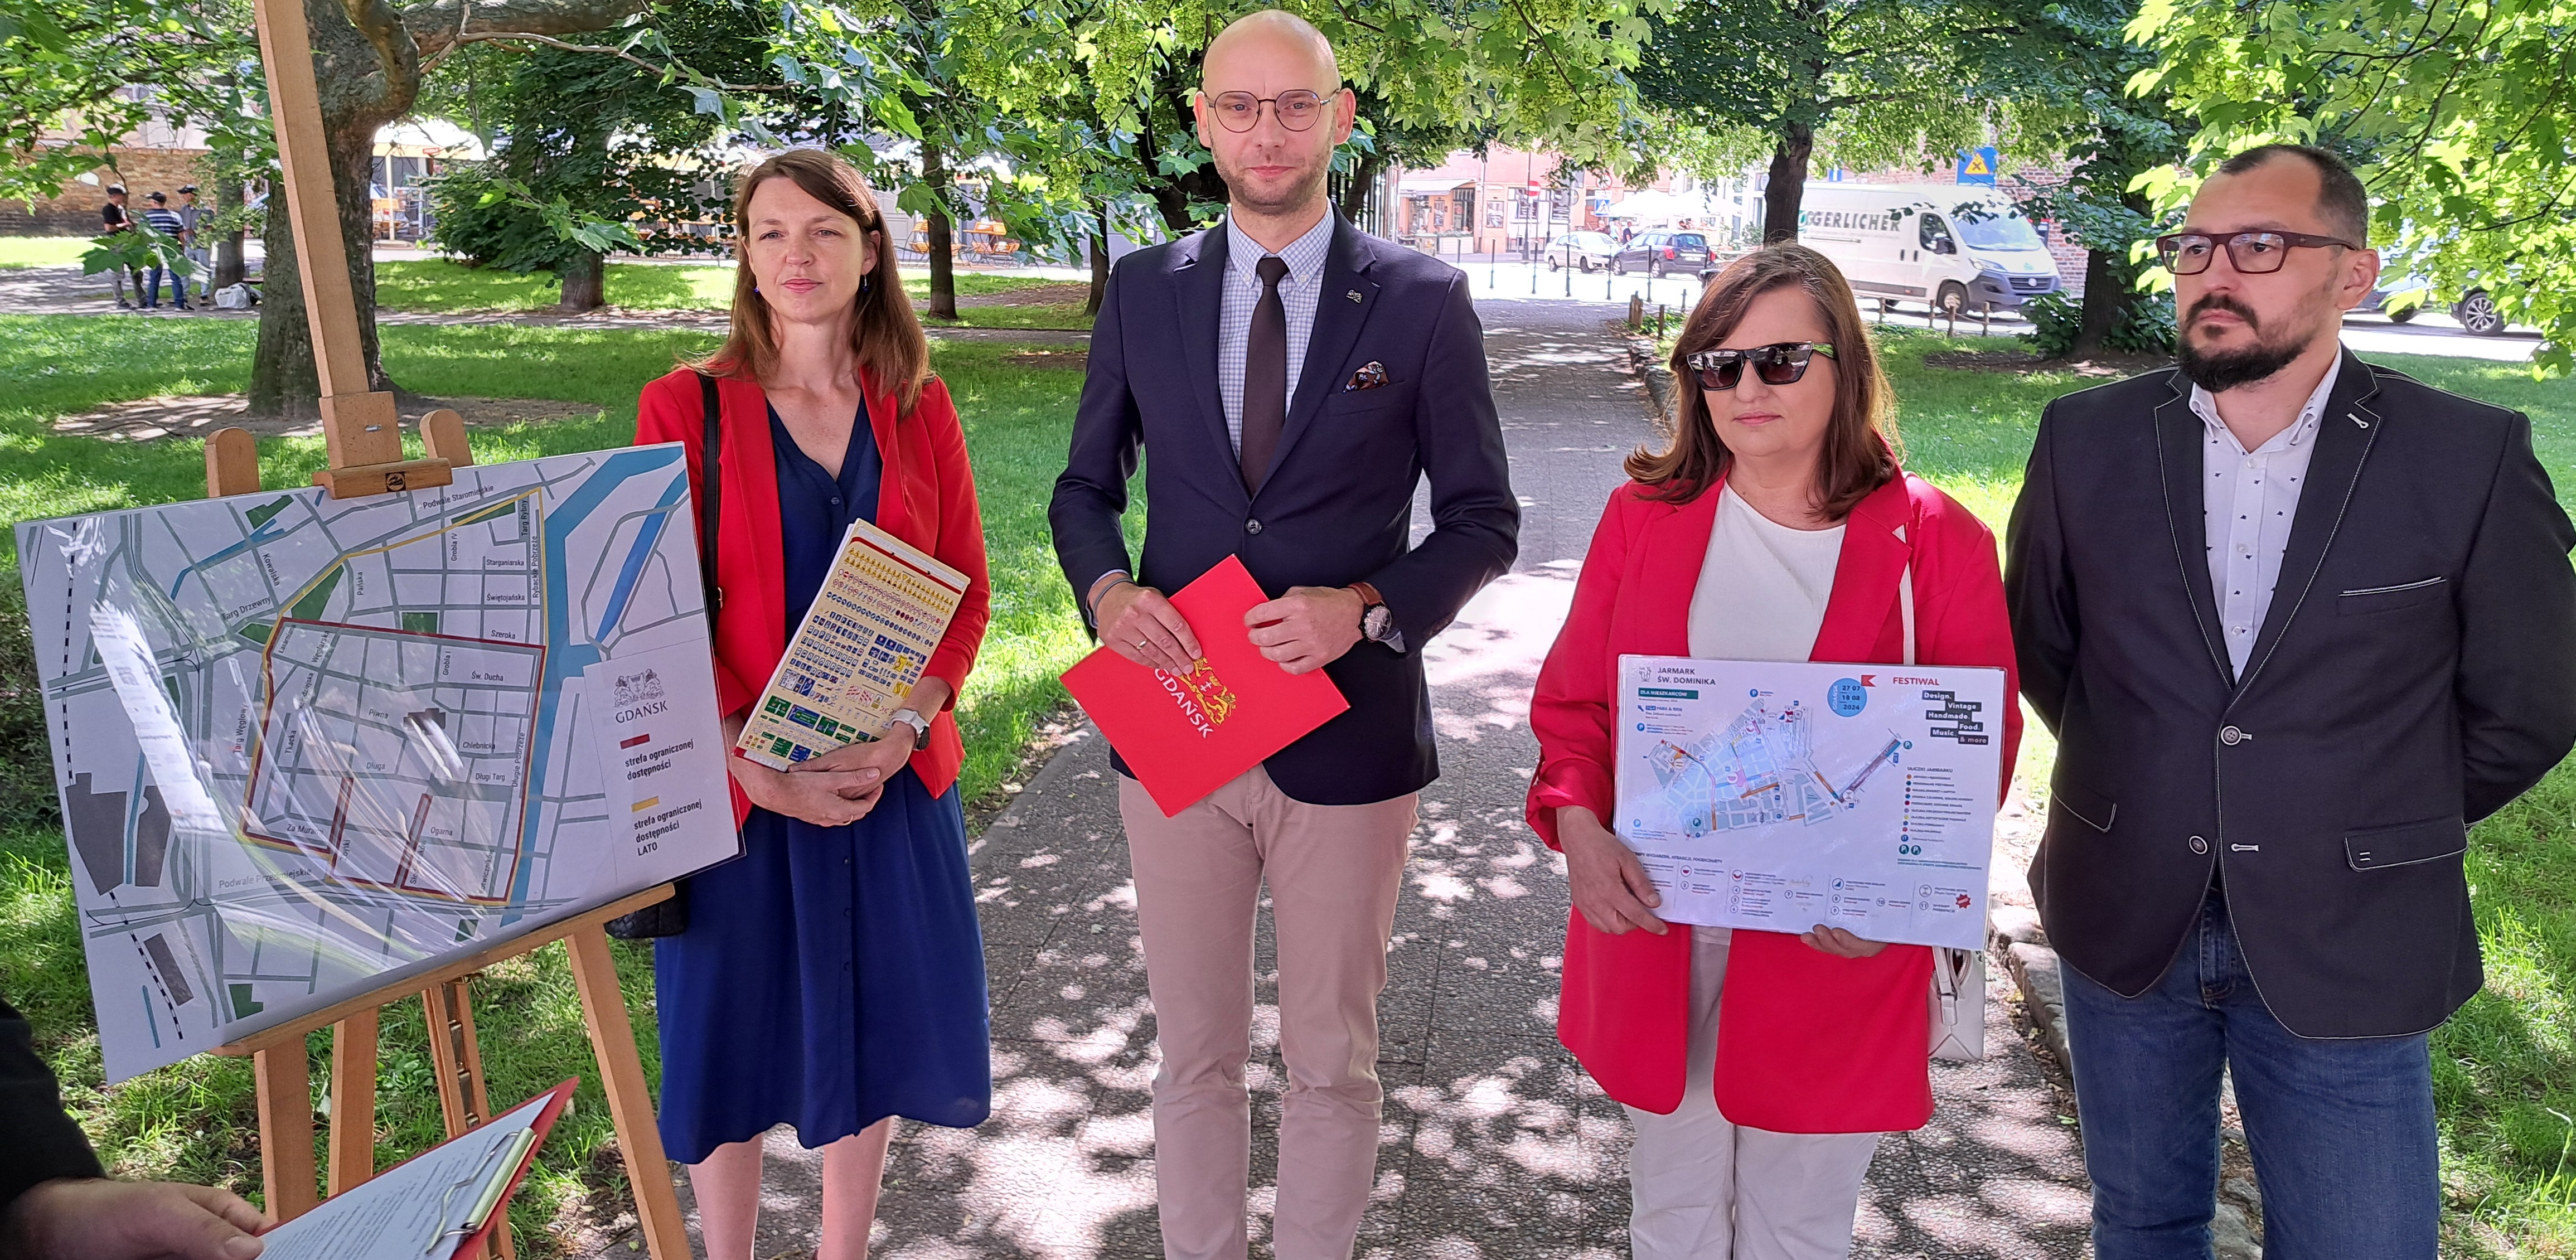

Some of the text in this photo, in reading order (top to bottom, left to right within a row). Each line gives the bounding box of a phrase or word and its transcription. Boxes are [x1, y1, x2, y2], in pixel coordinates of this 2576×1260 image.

[423, 484, 494, 510] Podwale Staromiejskie
[520, 500, 529, 536] Targ Rybny
[262, 553, 280, 587] Kowalska
[531, 536, 540, 598] Rybackie Pobrzeże
[239, 596, 271, 613] Drzewny
[486, 593, 525, 603] Świętojańska
[491, 630, 516, 640] Szeroka
[311, 630, 330, 663] Węglarska
[443, 653, 451, 676] Grobla
[1658, 667, 1696, 675] JARMARK
[471, 670, 503, 681] Św. Ducha
[1657, 675, 1716, 686] ŚW. DOMINIKA
[1893, 677, 1940, 686] FESTIWAL
[1154, 668, 1214, 739] GDAŃSK
[1948, 702, 1977, 711] Vintage
[369, 709, 389, 719] Piwna
[616, 700, 669, 724] GDAŃSK
[233, 703, 249, 754] Targ Węglowy
[284, 730, 297, 754] Tkacka
[462, 741, 496, 750] Chlebnicka
[625, 738, 694, 768] strefa ograniczonej
[366, 762, 385, 770] Długa
[627, 759, 671, 781] dostępności
[475, 773, 506, 782] Długi Targ
[634, 798, 703, 830] strefa ograniczonej
[286, 823, 296, 832] Za
[430, 826, 453, 836] Ogarna
[636, 820, 680, 843] dostępności
[637, 841, 658, 856] LATO
[219, 876, 254, 889] Podwale
